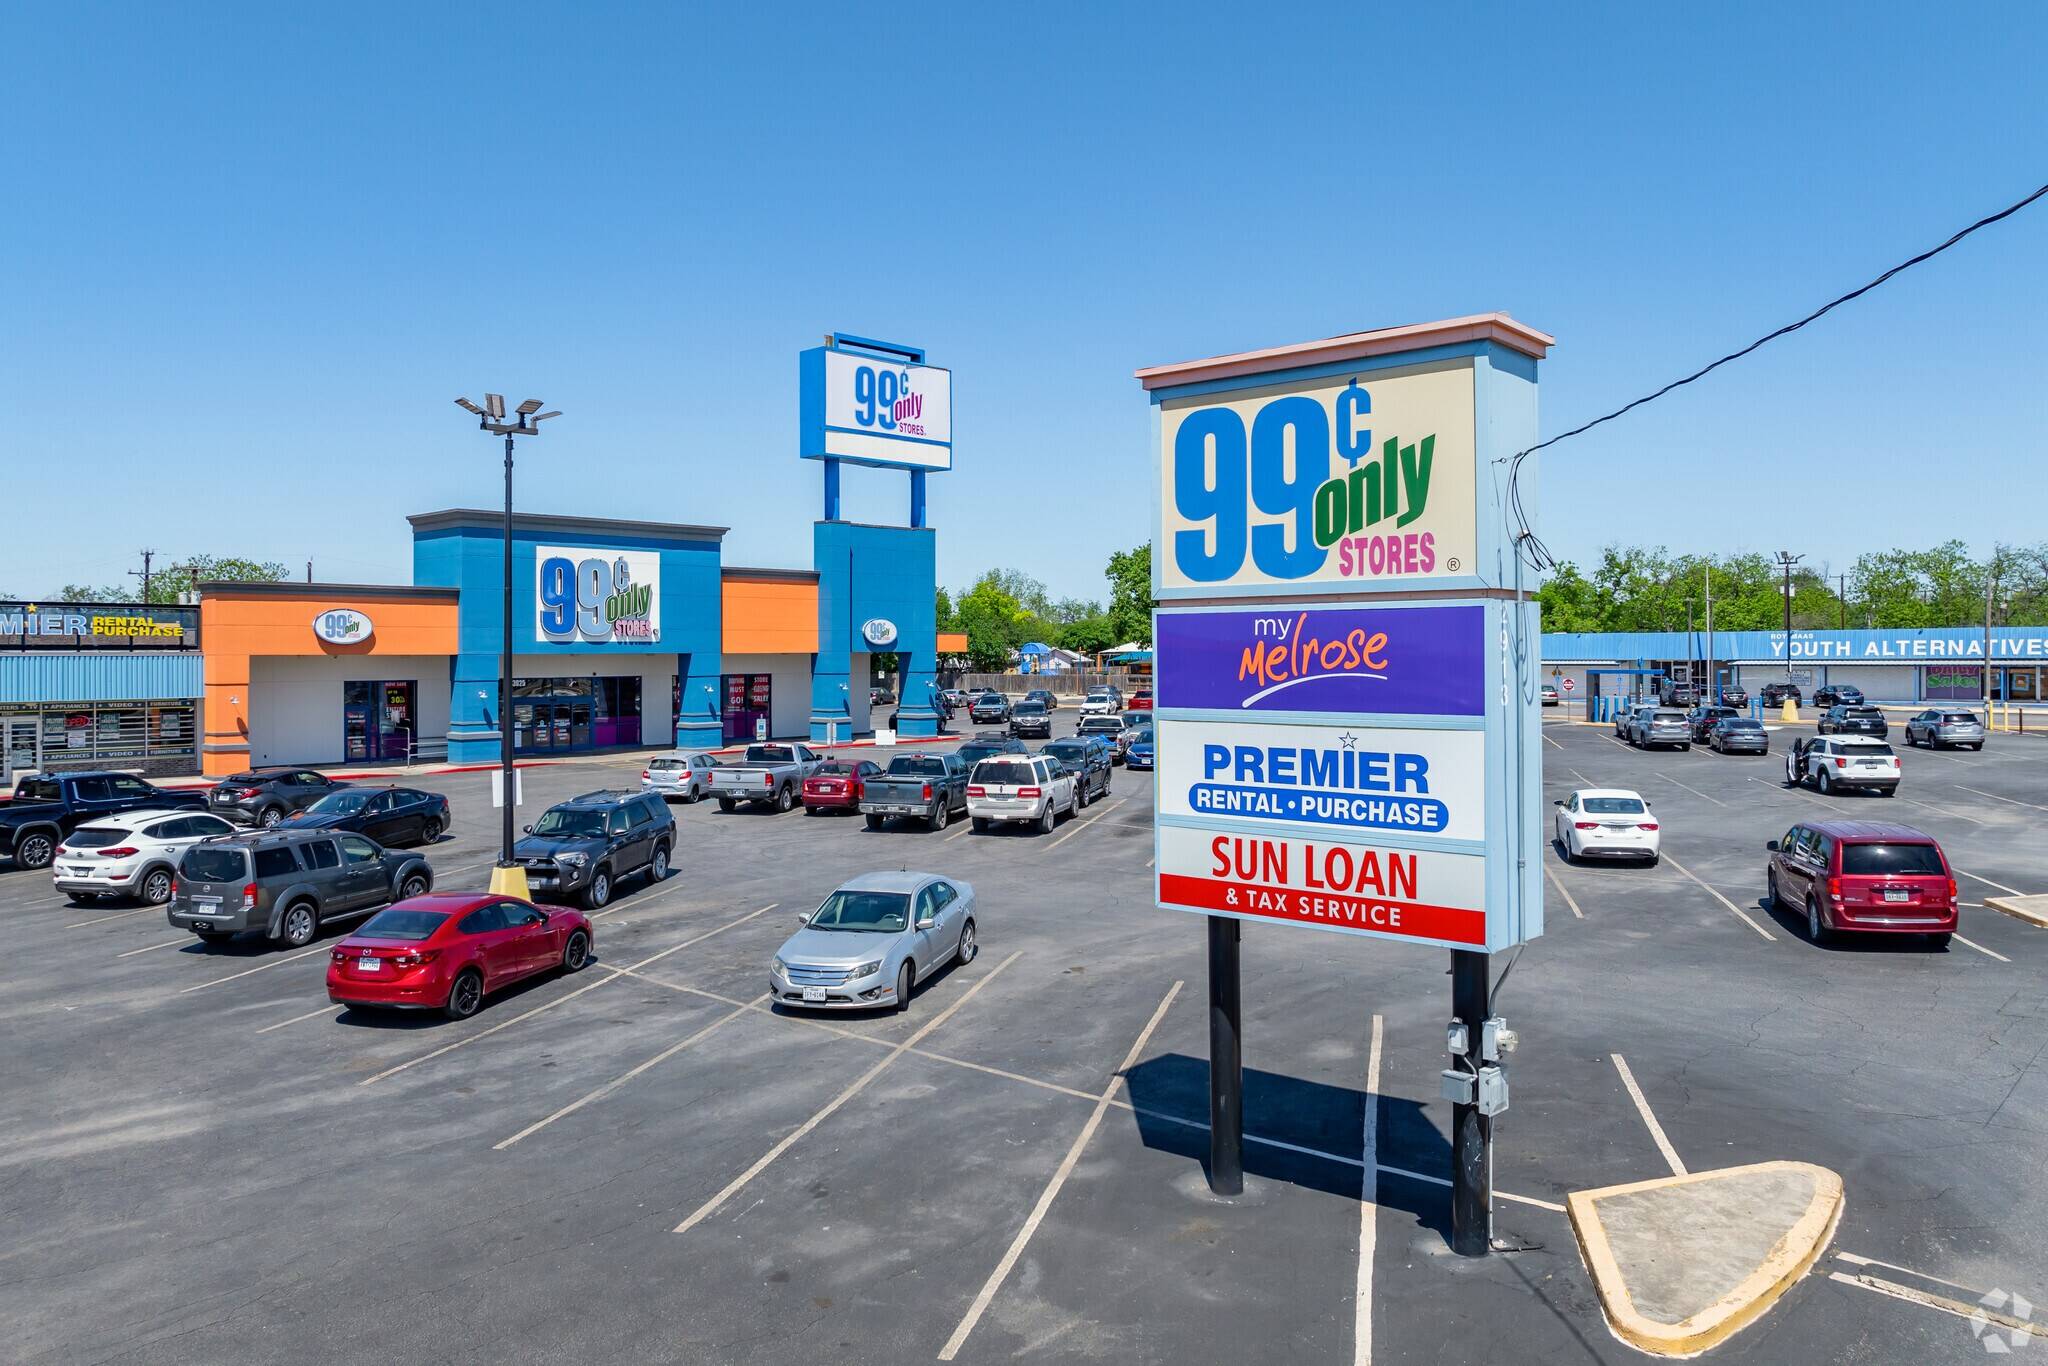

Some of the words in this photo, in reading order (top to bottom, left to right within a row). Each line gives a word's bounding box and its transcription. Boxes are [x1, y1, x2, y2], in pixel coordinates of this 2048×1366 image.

[855, 366, 909, 430] 99¢
[894, 392, 922, 421] only
[899, 422, 924, 436] STORES
[1175, 377, 1372, 582] 99¢
[1315, 433, 1436, 547] only
[1338, 532, 1436, 577] STORES
[540, 556, 630, 636] 99¢
[605, 582, 652, 623] only
[92, 616, 155, 627] RENTAL
[92, 626, 184, 637] PURCHASE
[325, 614, 352, 638] 99¢
[345, 621, 360, 633] only
[615, 619, 652, 637] STORES
[1254, 617, 1292, 640] my
[1239, 612, 1388, 686] Melrose
[1771, 641, 1850, 656] YOUTH
[730, 696, 744, 704] GO!
[1204, 744, 1429, 793] PREMIER
[1197, 788, 1282, 814] RENTAL
[1301, 796, 1438, 826] PURCHASE
[1212, 836, 1287, 885] SUN
[1305, 845, 1417, 900] LOAN
[1226, 888, 1239, 906] &
[1247, 890, 1287, 912] TAX
[1299, 896, 1400, 927] SERVICE
